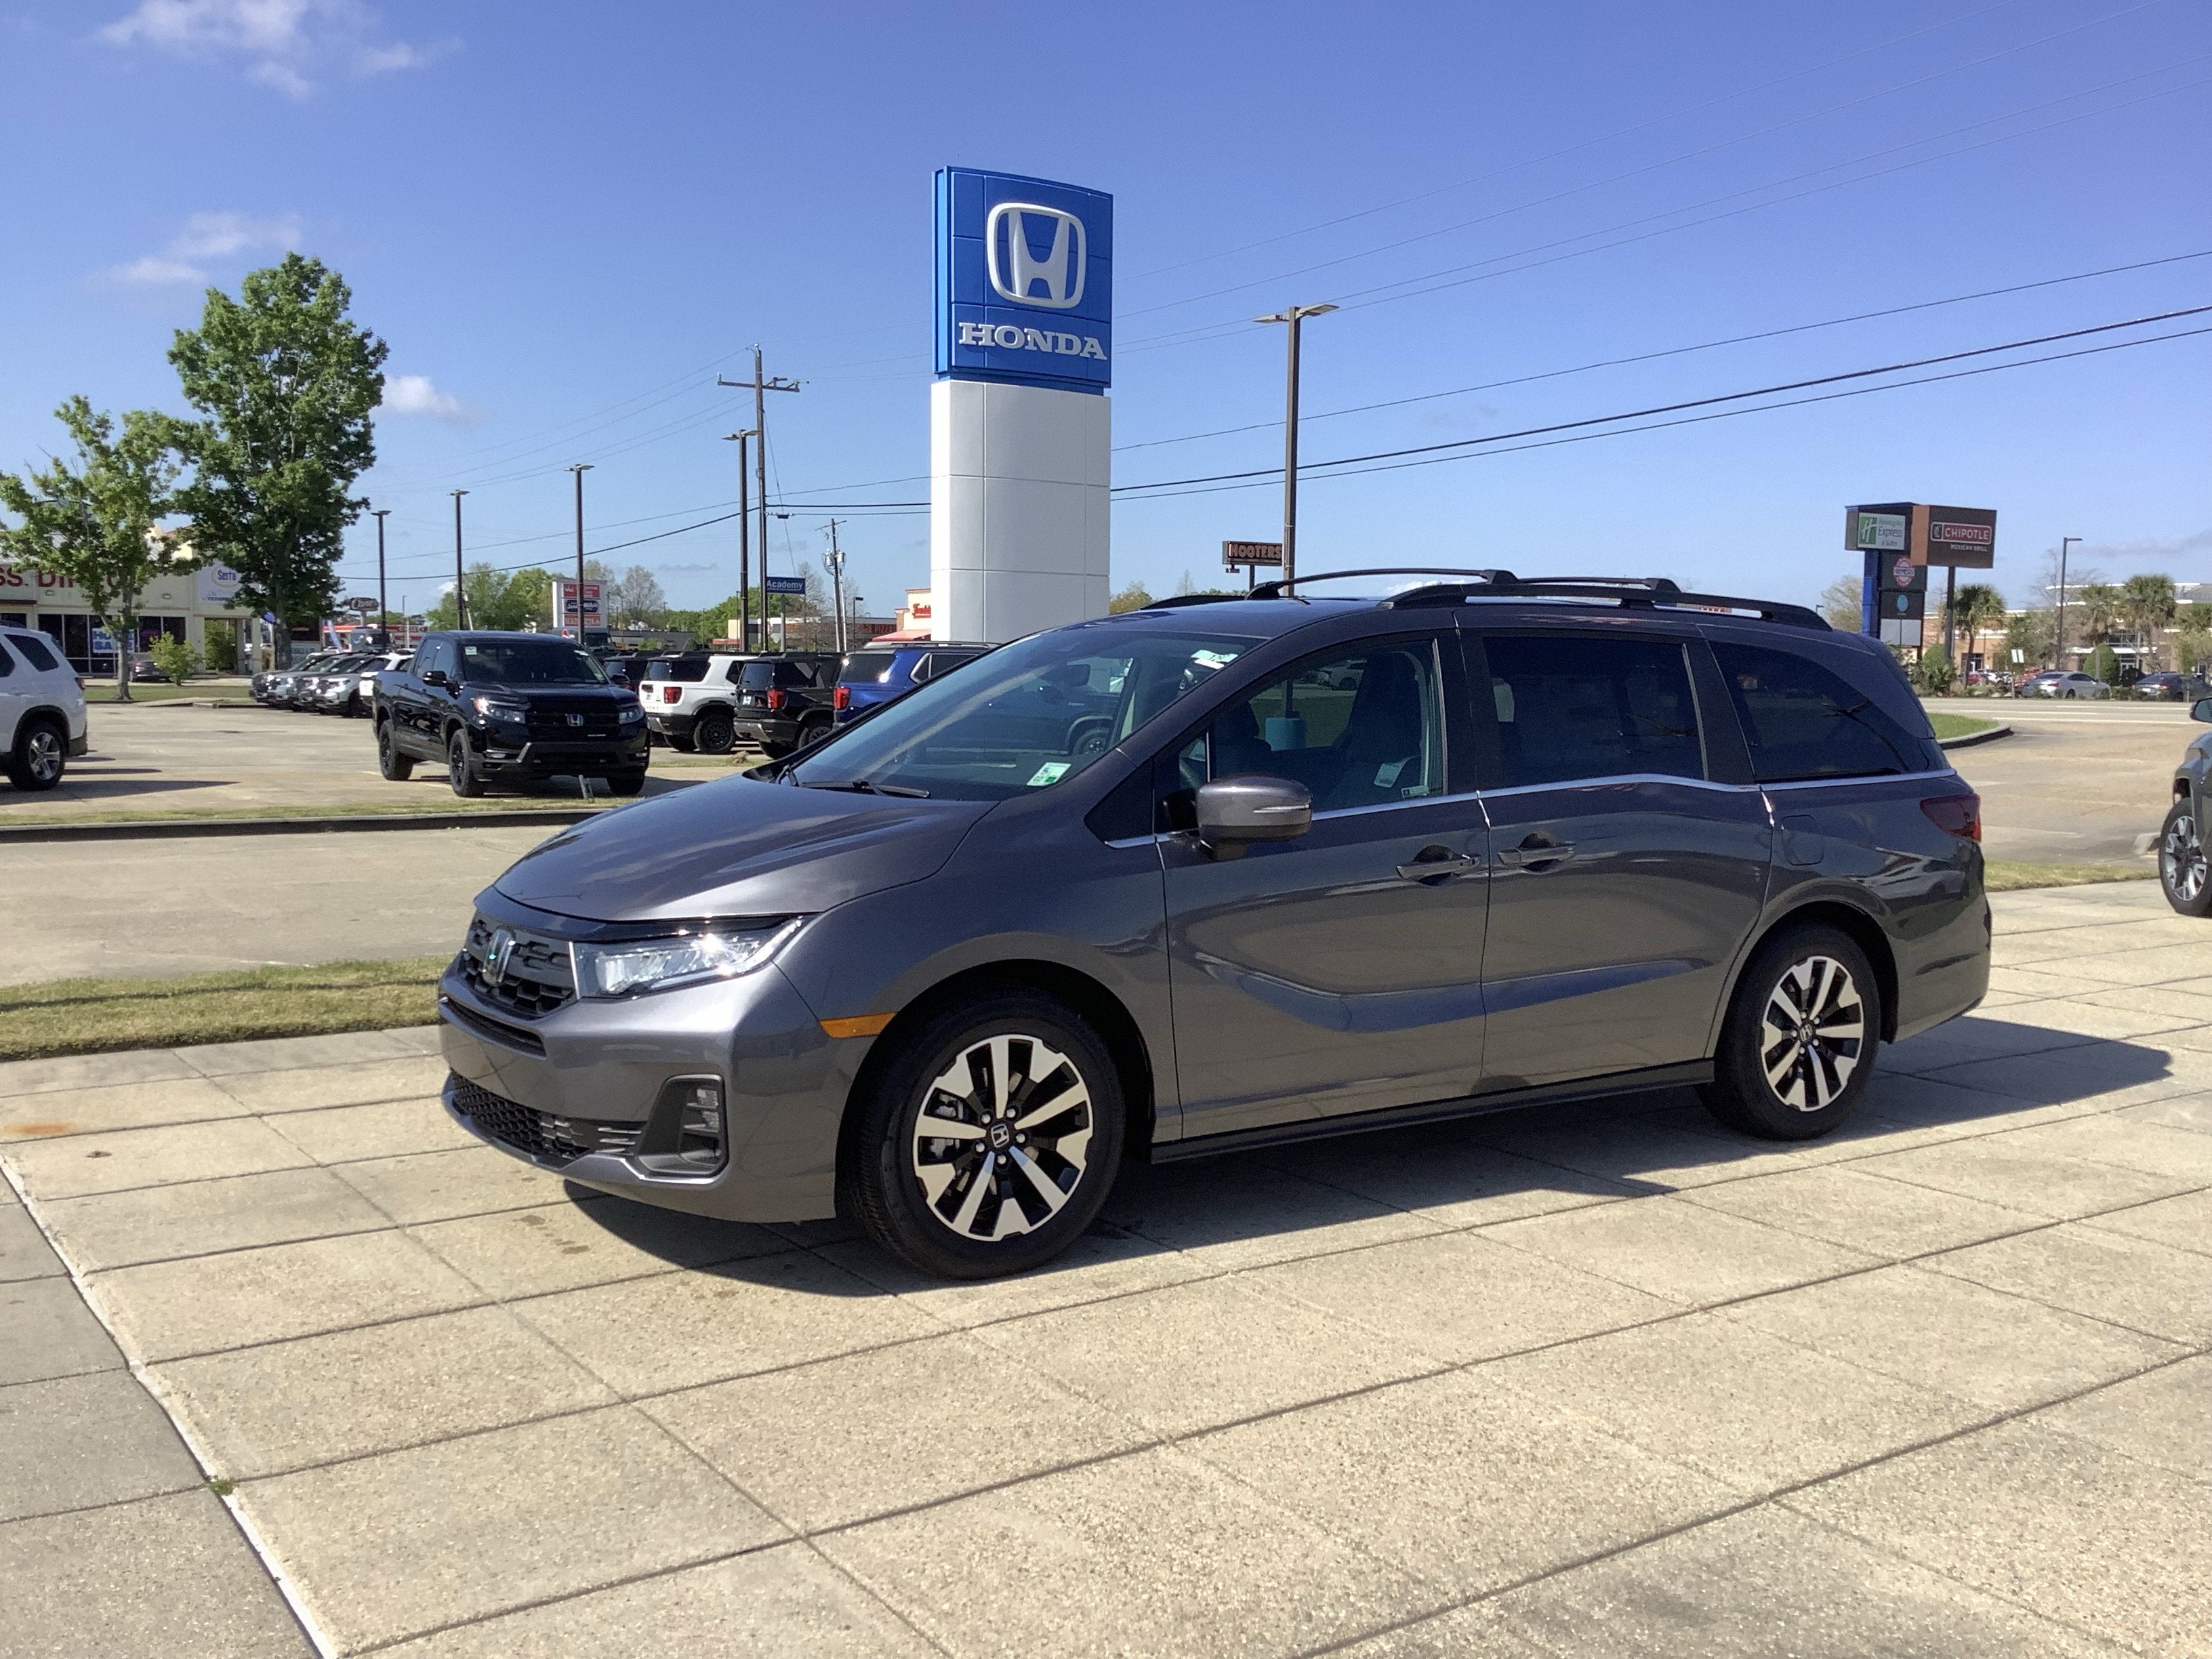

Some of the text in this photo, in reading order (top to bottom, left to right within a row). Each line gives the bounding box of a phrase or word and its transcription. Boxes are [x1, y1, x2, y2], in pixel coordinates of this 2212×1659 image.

[958, 323, 1107, 361] HONDA
[1878, 525, 1903, 537] Express
[1945, 527, 1988, 539] CHIPOTLE
[1229, 544, 1281, 559] HOOTERS
[767, 580, 802, 590] Academy
